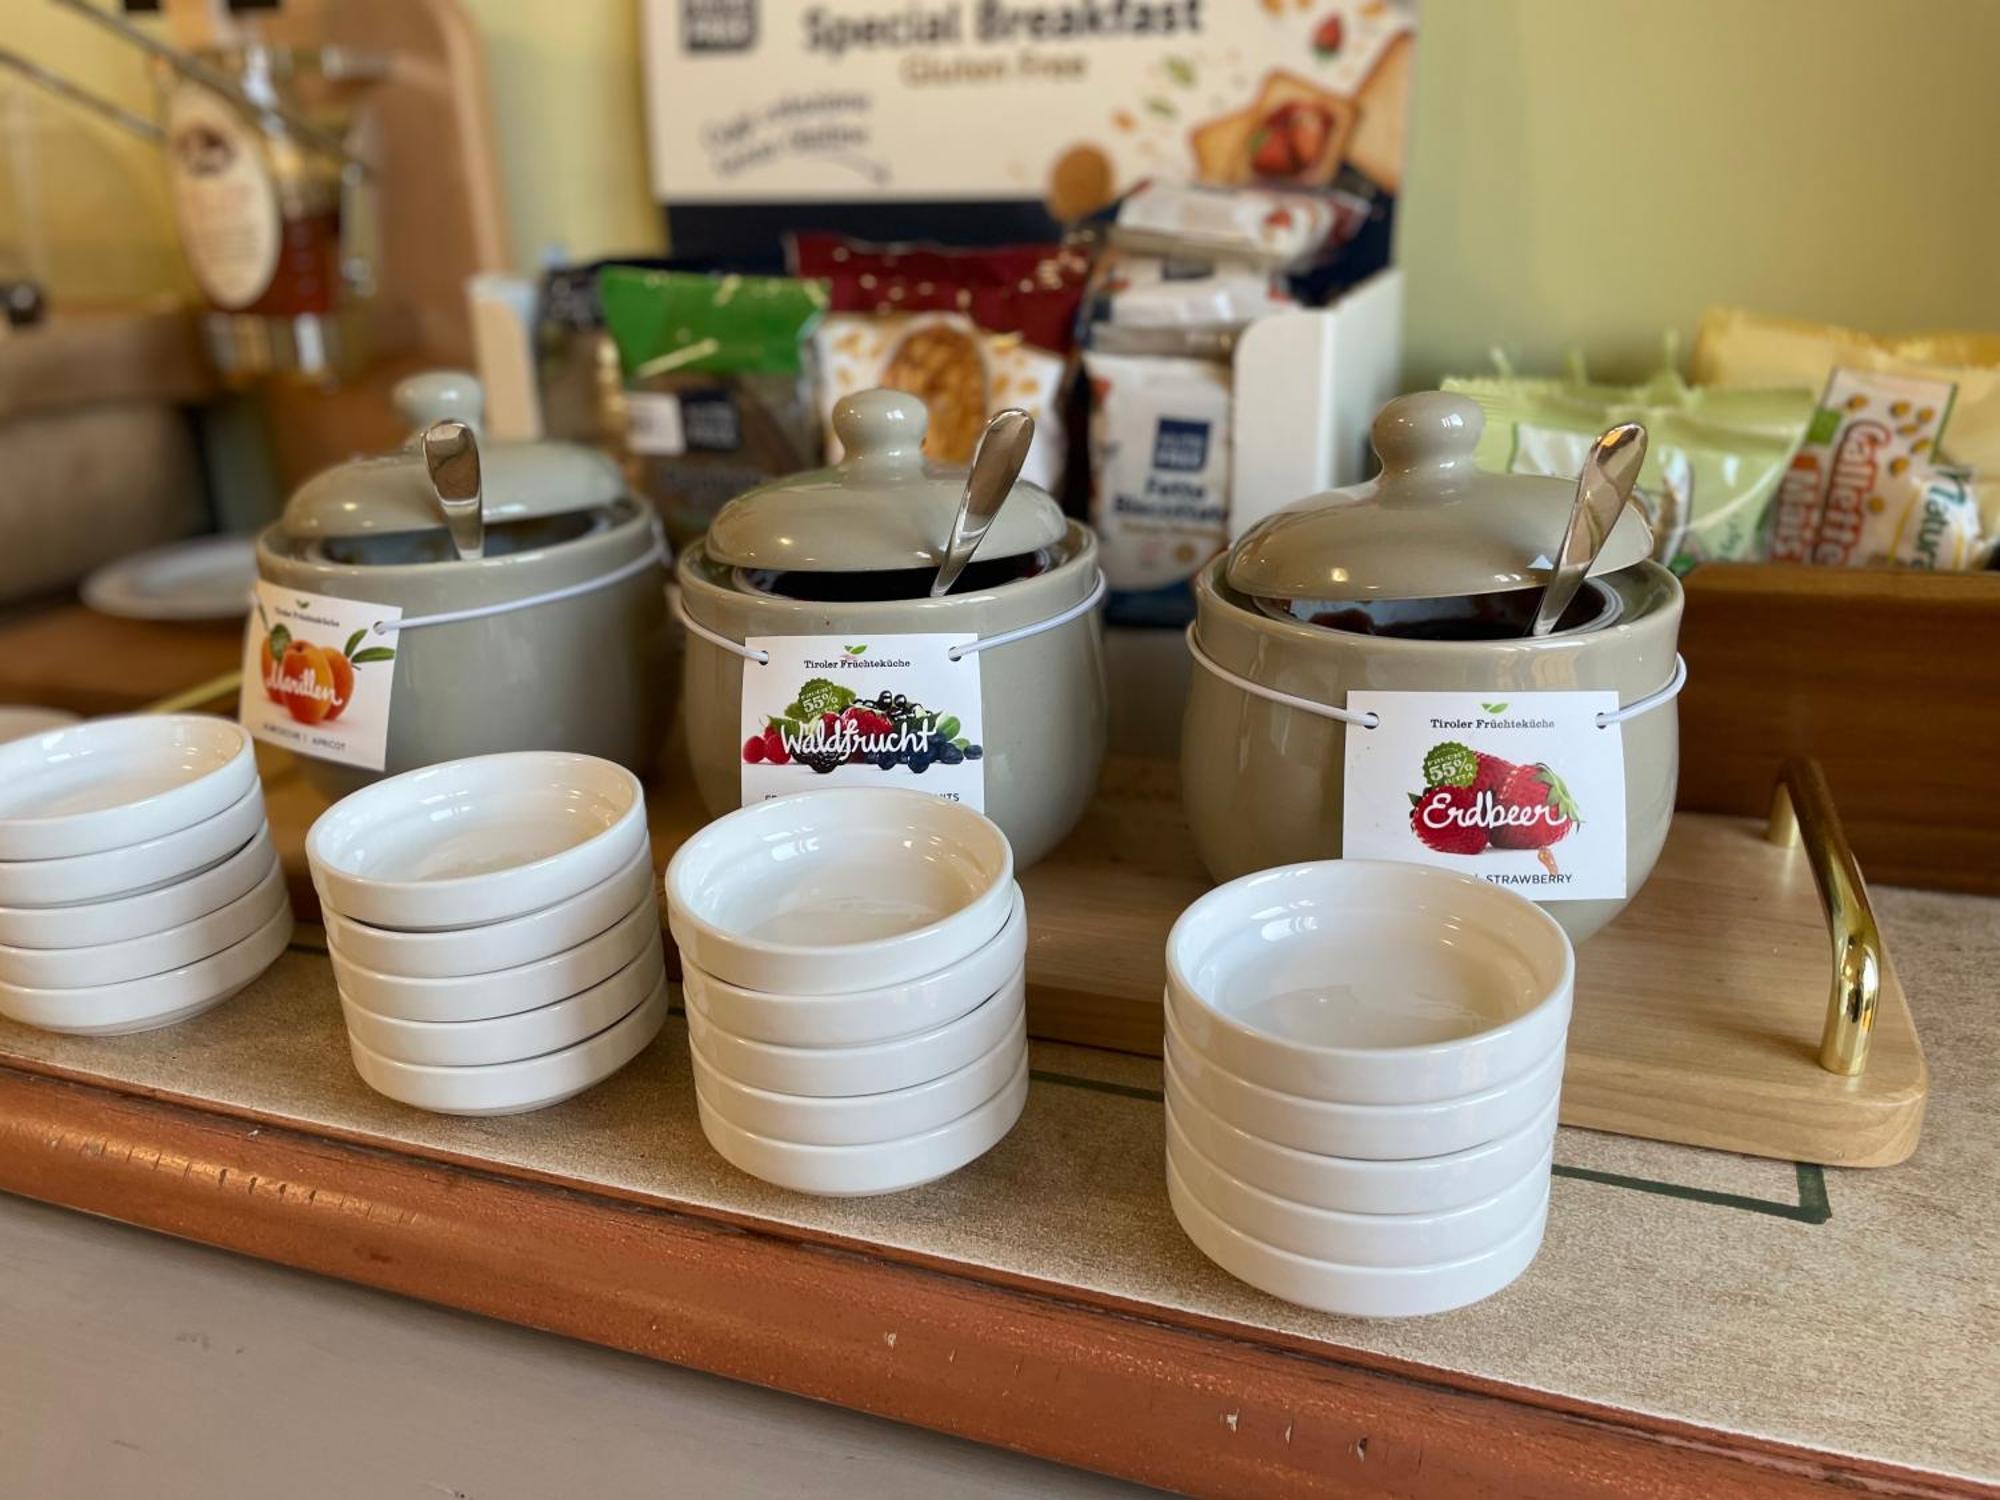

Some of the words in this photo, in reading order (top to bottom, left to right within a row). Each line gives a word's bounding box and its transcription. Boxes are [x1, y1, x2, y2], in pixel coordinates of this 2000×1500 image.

[804, 2, 962, 60] Special
[976, 0, 1203, 43] Breakfast
[903, 54, 1006, 85] Gluten
[1019, 50, 1087, 80] Free
[803, 660, 838, 669] Tiroler
[840, 658, 911, 669] Früchteküche
[803, 692, 838, 713] 55%
[1430, 718, 1473, 729] Tiroler
[1475, 718, 1556, 729] Früchteküche
[780, 717, 937, 761] Waldfrucht
[1429, 757, 1473, 781] 55%
[1423, 790, 1568, 829] Erdbeer
[1486, 873, 1573, 885] STRAWBERRY
